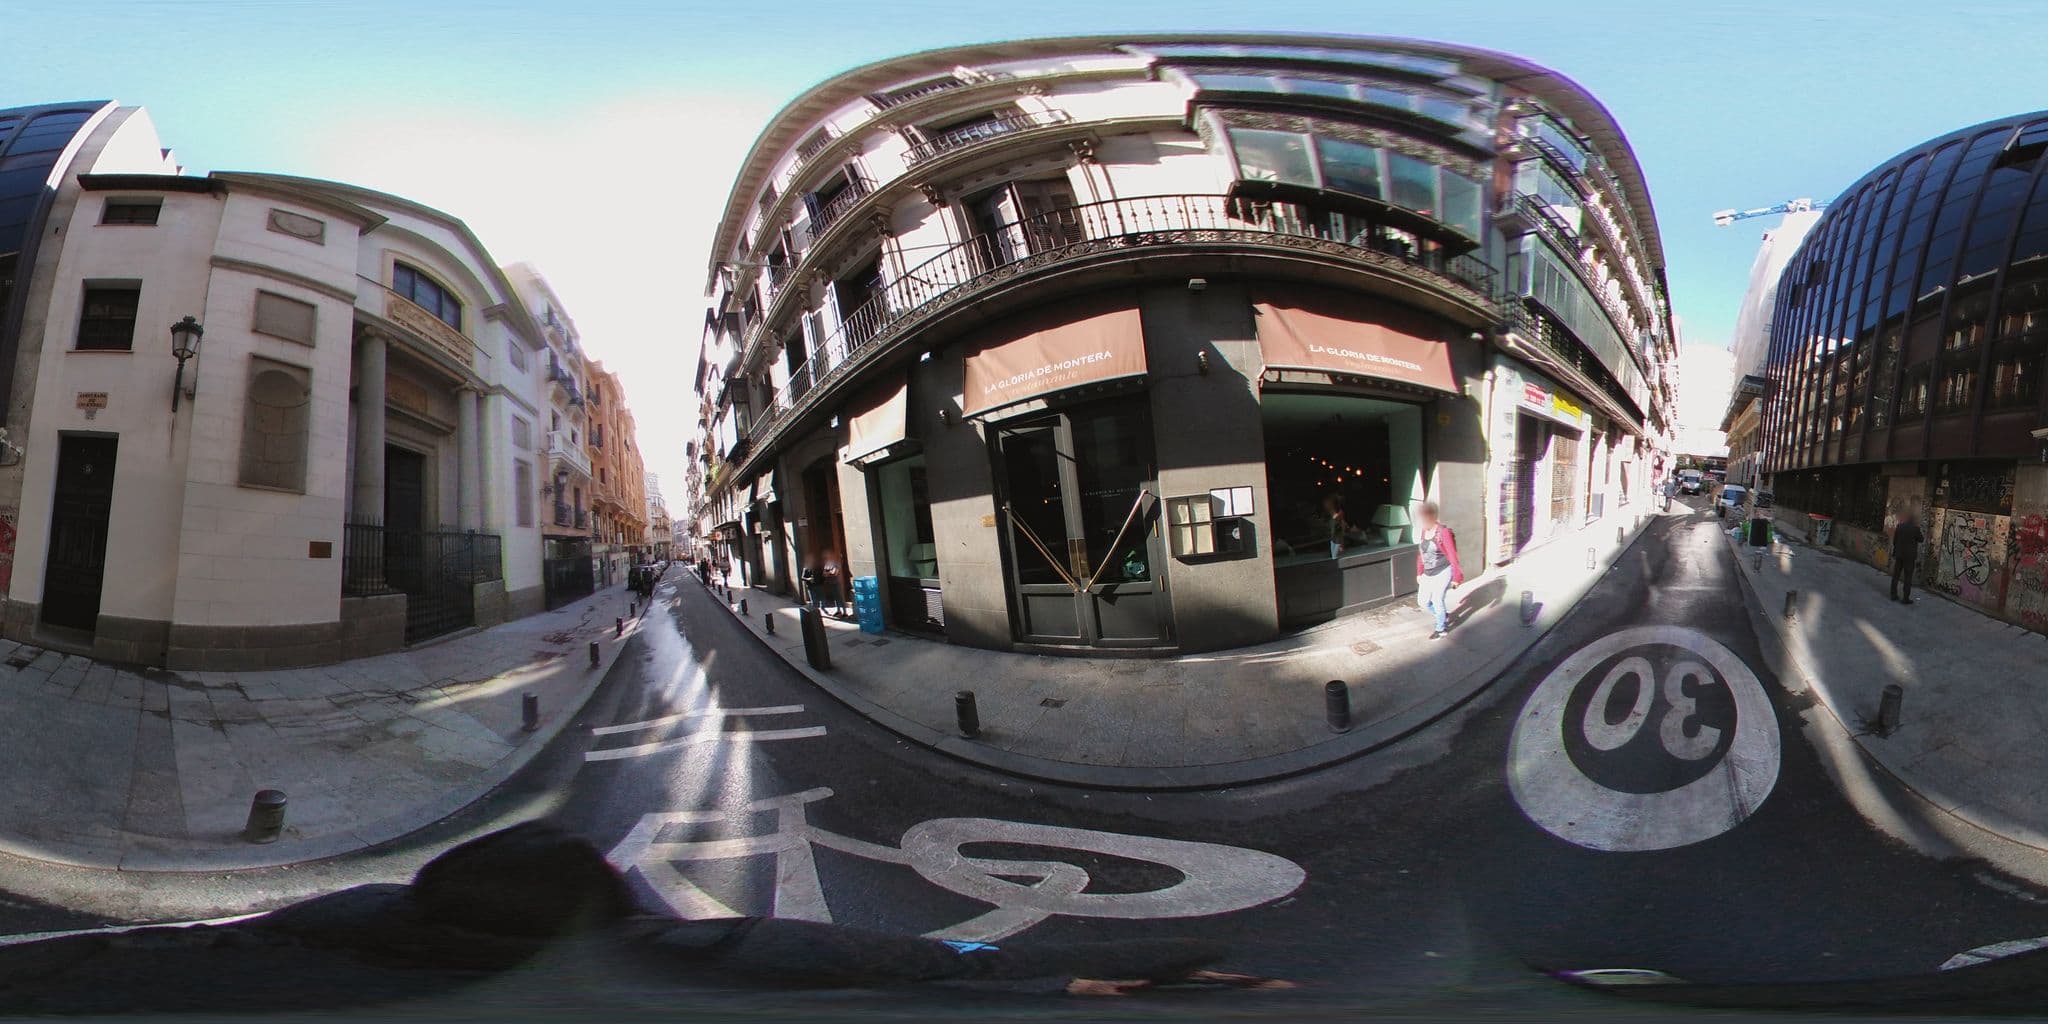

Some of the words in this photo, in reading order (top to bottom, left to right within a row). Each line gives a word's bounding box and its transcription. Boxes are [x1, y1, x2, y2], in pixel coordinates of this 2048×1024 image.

[984, 383, 998, 394] LA
[998, 370, 1036, 389] GLORIA
[1036, 364, 1053, 376] DE
[1053, 350, 1113, 372] MONTERA
[1309, 344, 1326, 353] LA
[1326, 347, 1366, 361] GLORIA
[1366, 353, 1381, 363] DE
[1583, 656, 1722, 761] 30
